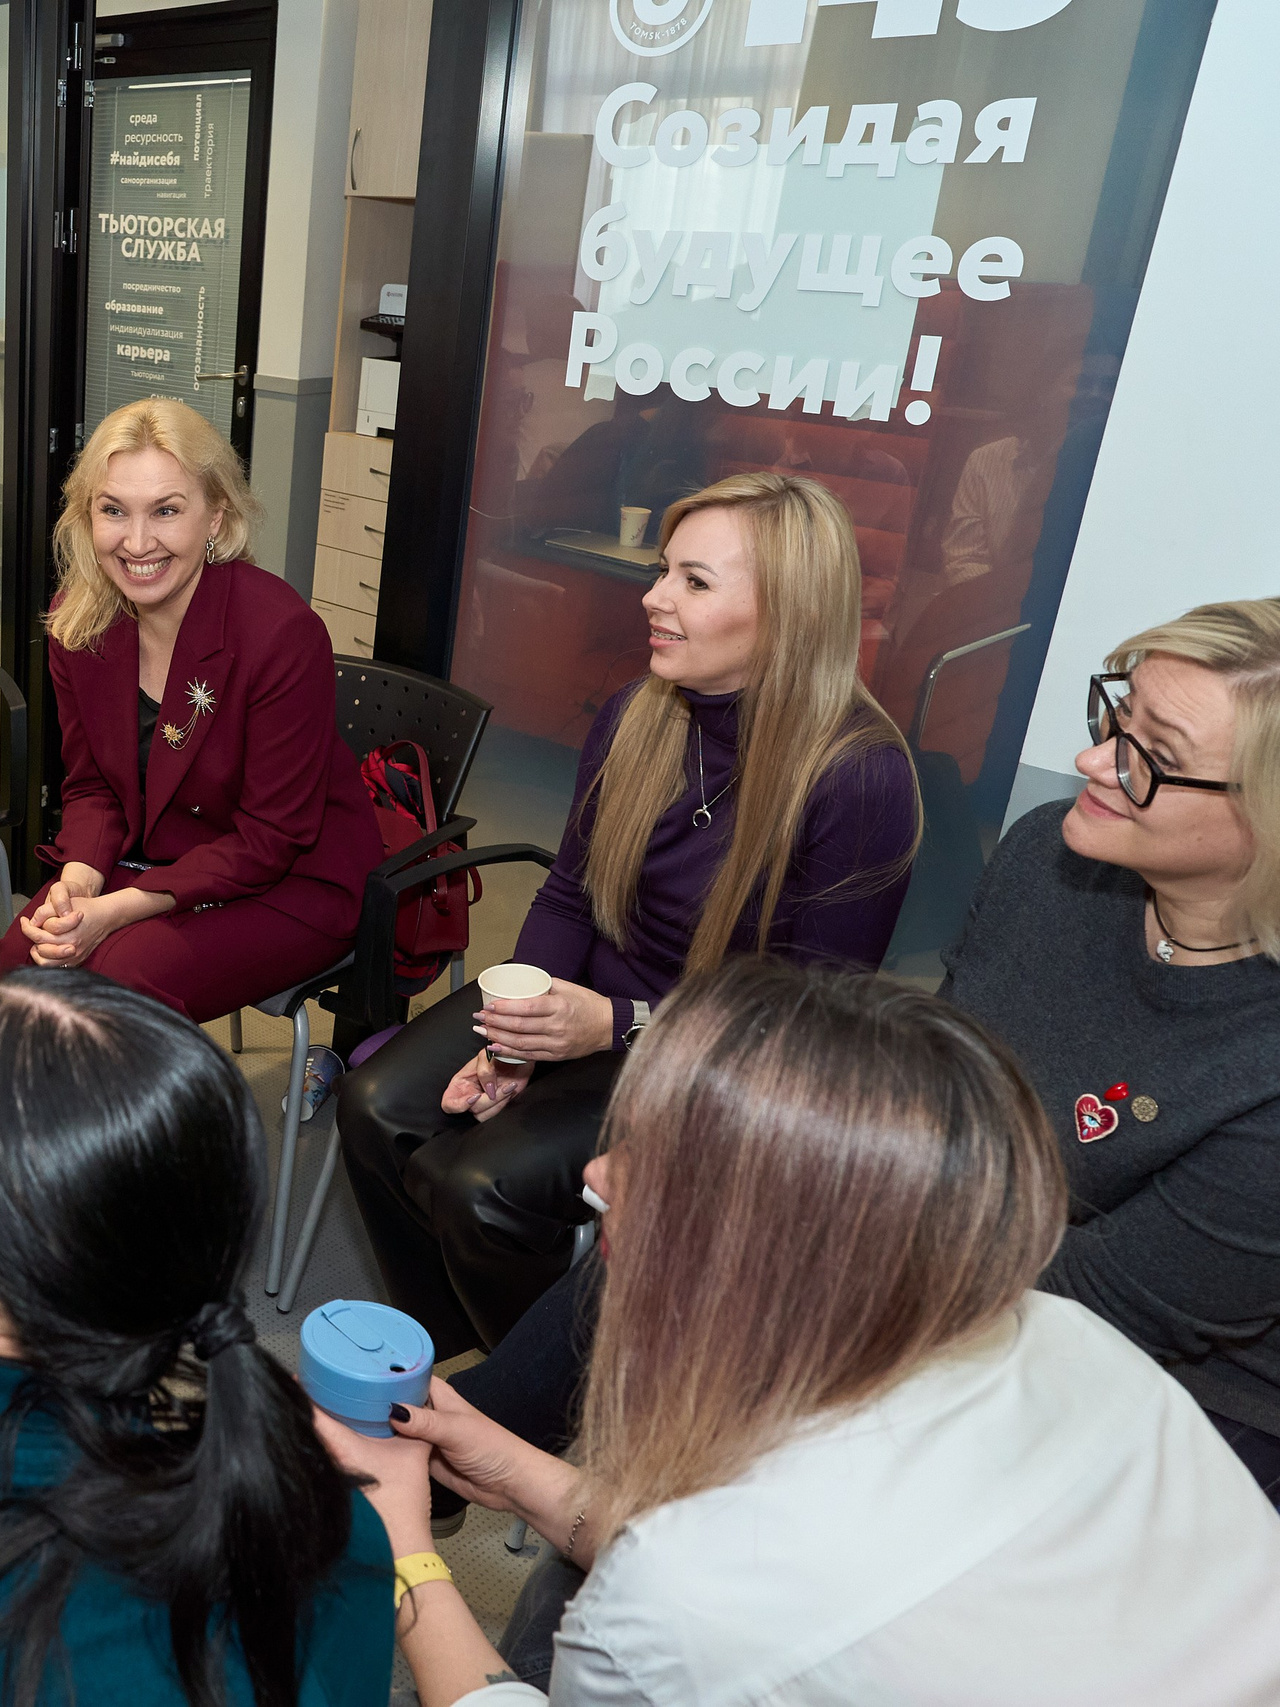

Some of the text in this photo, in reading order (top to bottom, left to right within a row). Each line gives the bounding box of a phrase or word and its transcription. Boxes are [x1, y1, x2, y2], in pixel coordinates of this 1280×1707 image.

[629, 17, 687, 40] TOMSK-1878
[129, 114, 158, 126] среда
[193, 93, 202, 161] потенциал
[595, 82, 1038, 178] Созидая
[124, 133, 183, 145] ресурсность
[110, 150, 180, 167] #найдисебя
[204, 123, 215, 198] траектория
[120, 177, 177, 186] самоорганизация
[98, 213, 226, 239] ТЬЮТОРСКАЯ
[121, 237, 201, 262] СЛУЖБА
[580, 201, 1025, 311] будущее
[122, 282, 181, 293] посредничество
[105, 299, 164, 315] образование
[109, 324, 184, 339] индивидуализация
[116, 343, 171, 364] карьера
[130, 370, 165, 380] тьюториал
[564, 311, 943, 425] России!
